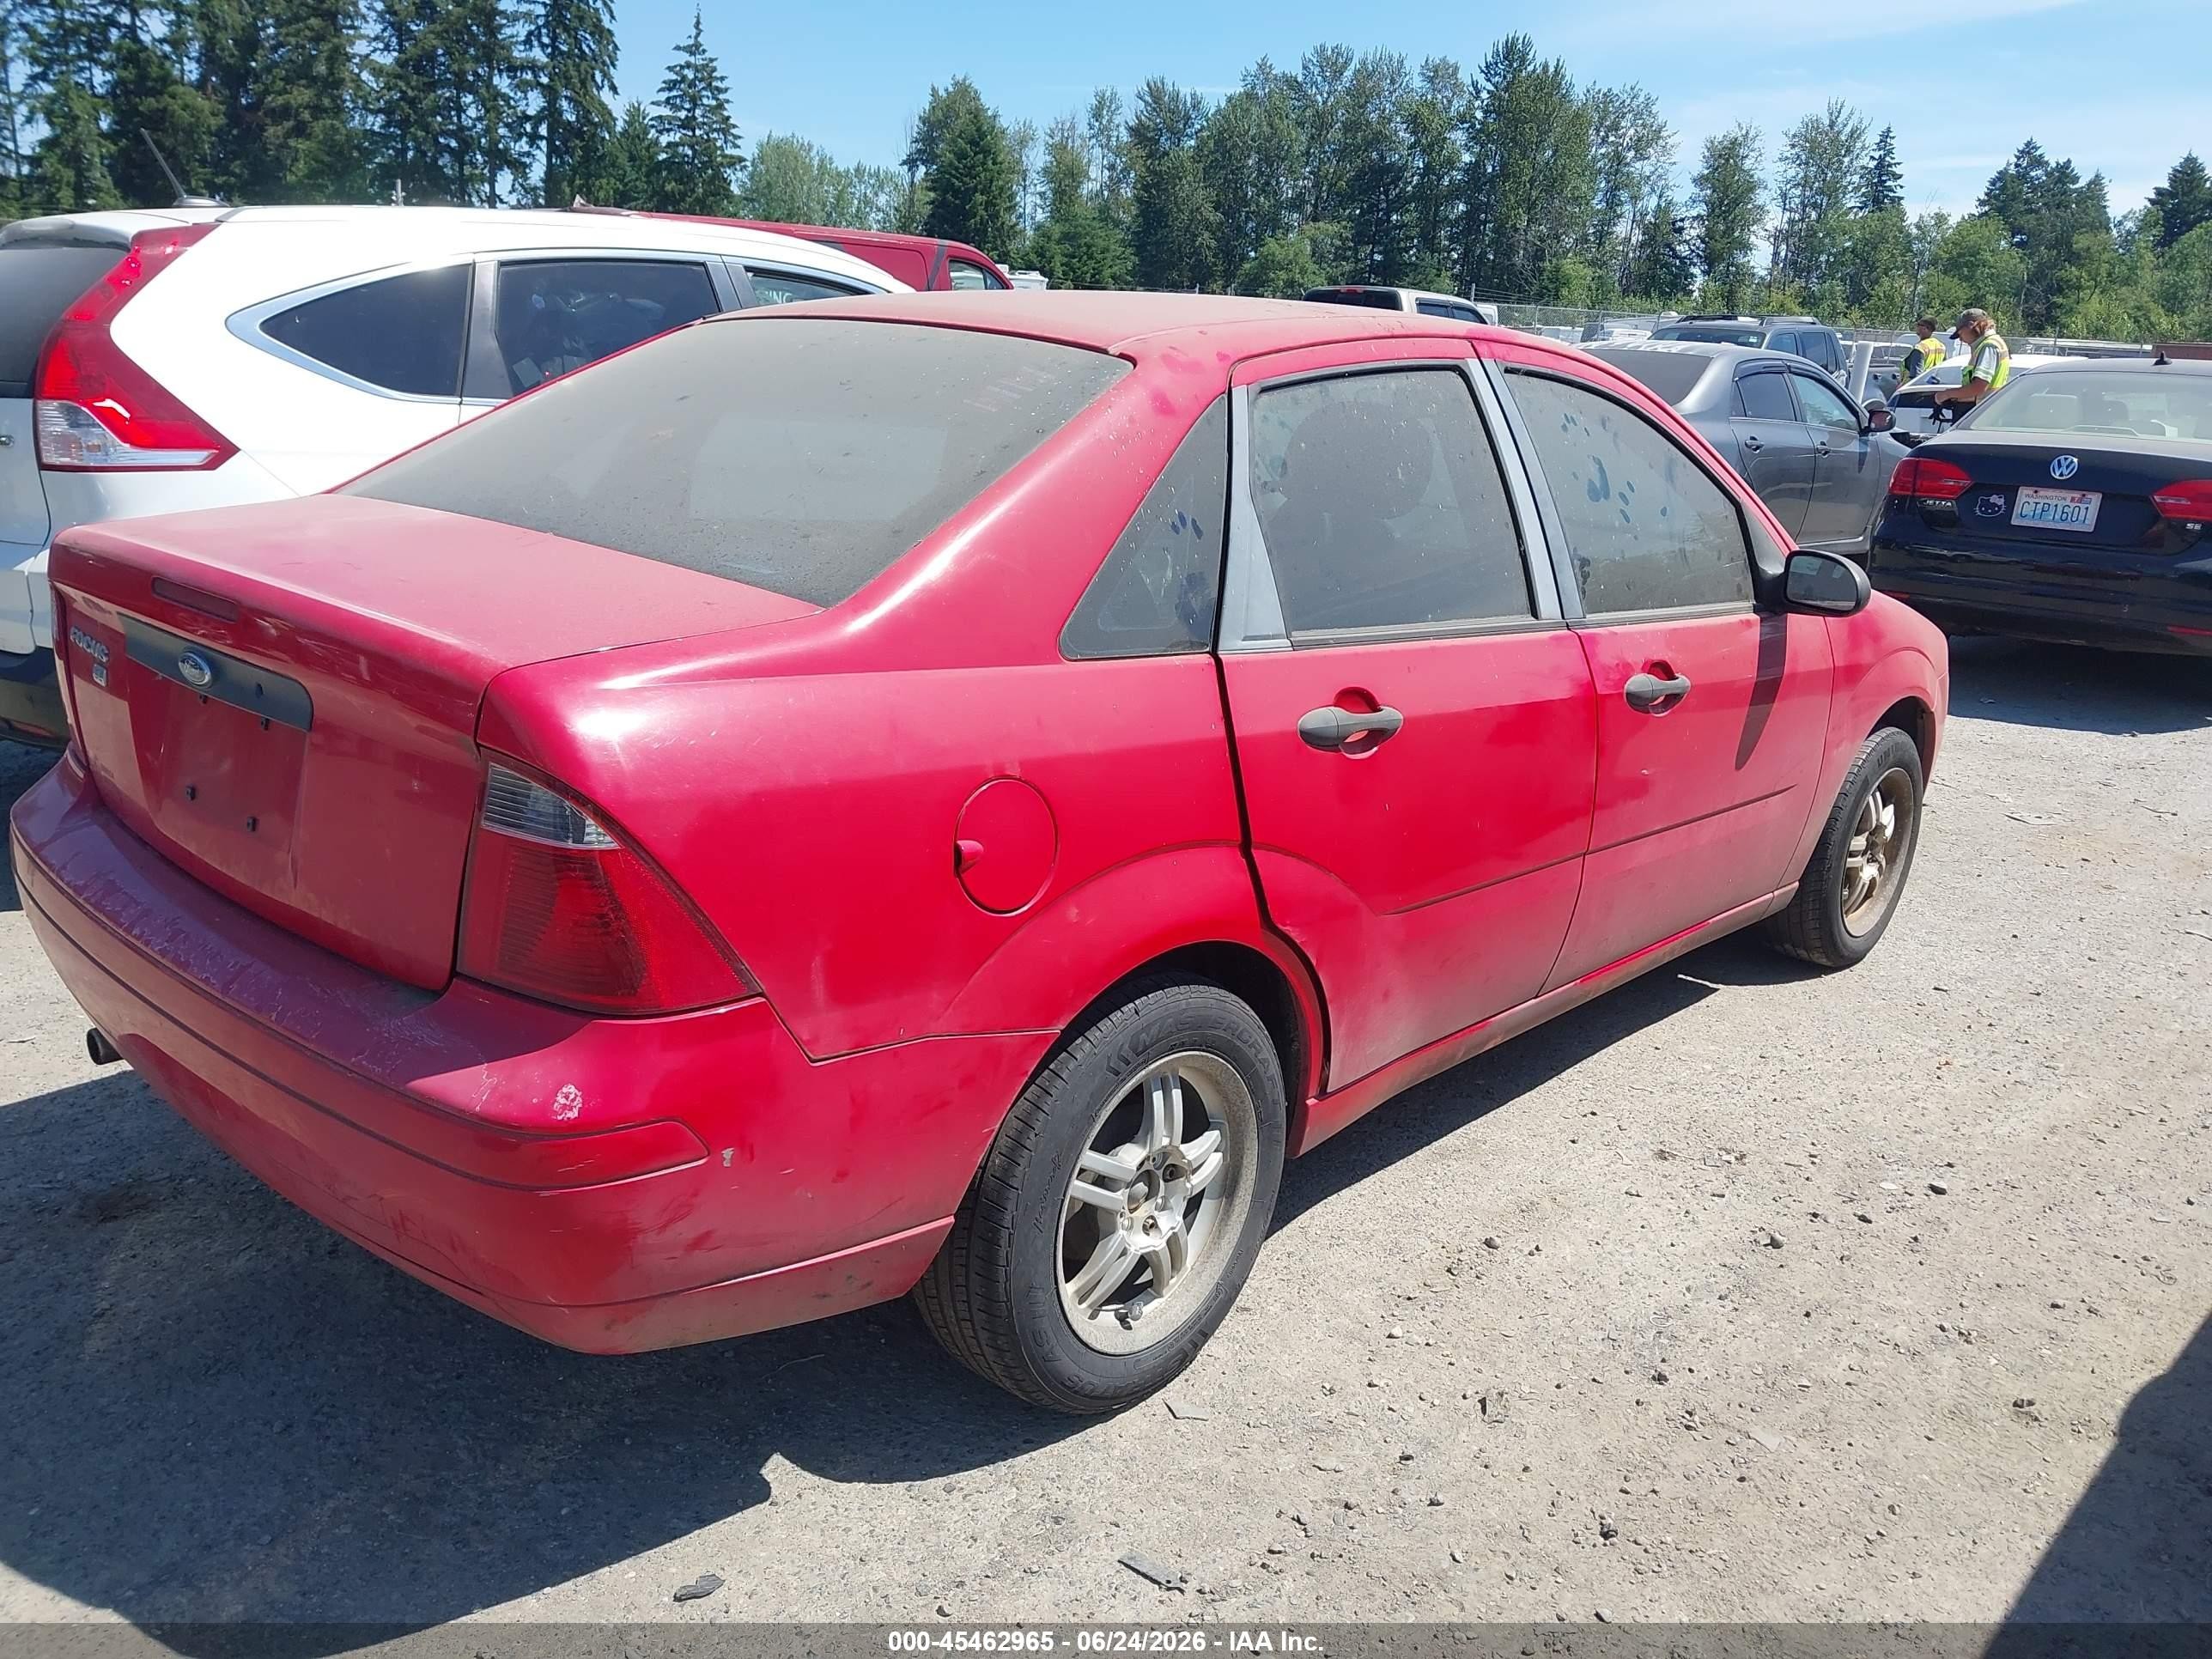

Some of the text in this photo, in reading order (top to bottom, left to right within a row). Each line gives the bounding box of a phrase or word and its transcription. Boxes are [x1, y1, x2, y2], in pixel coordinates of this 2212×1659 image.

[2020, 501, 2089, 524] CTP1601
[2025, 493, 2068, 502] WASHINGTON
[70, 626, 110, 663] FOCUS
[1136, 1014, 1279, 1094] MASERCRAFT
